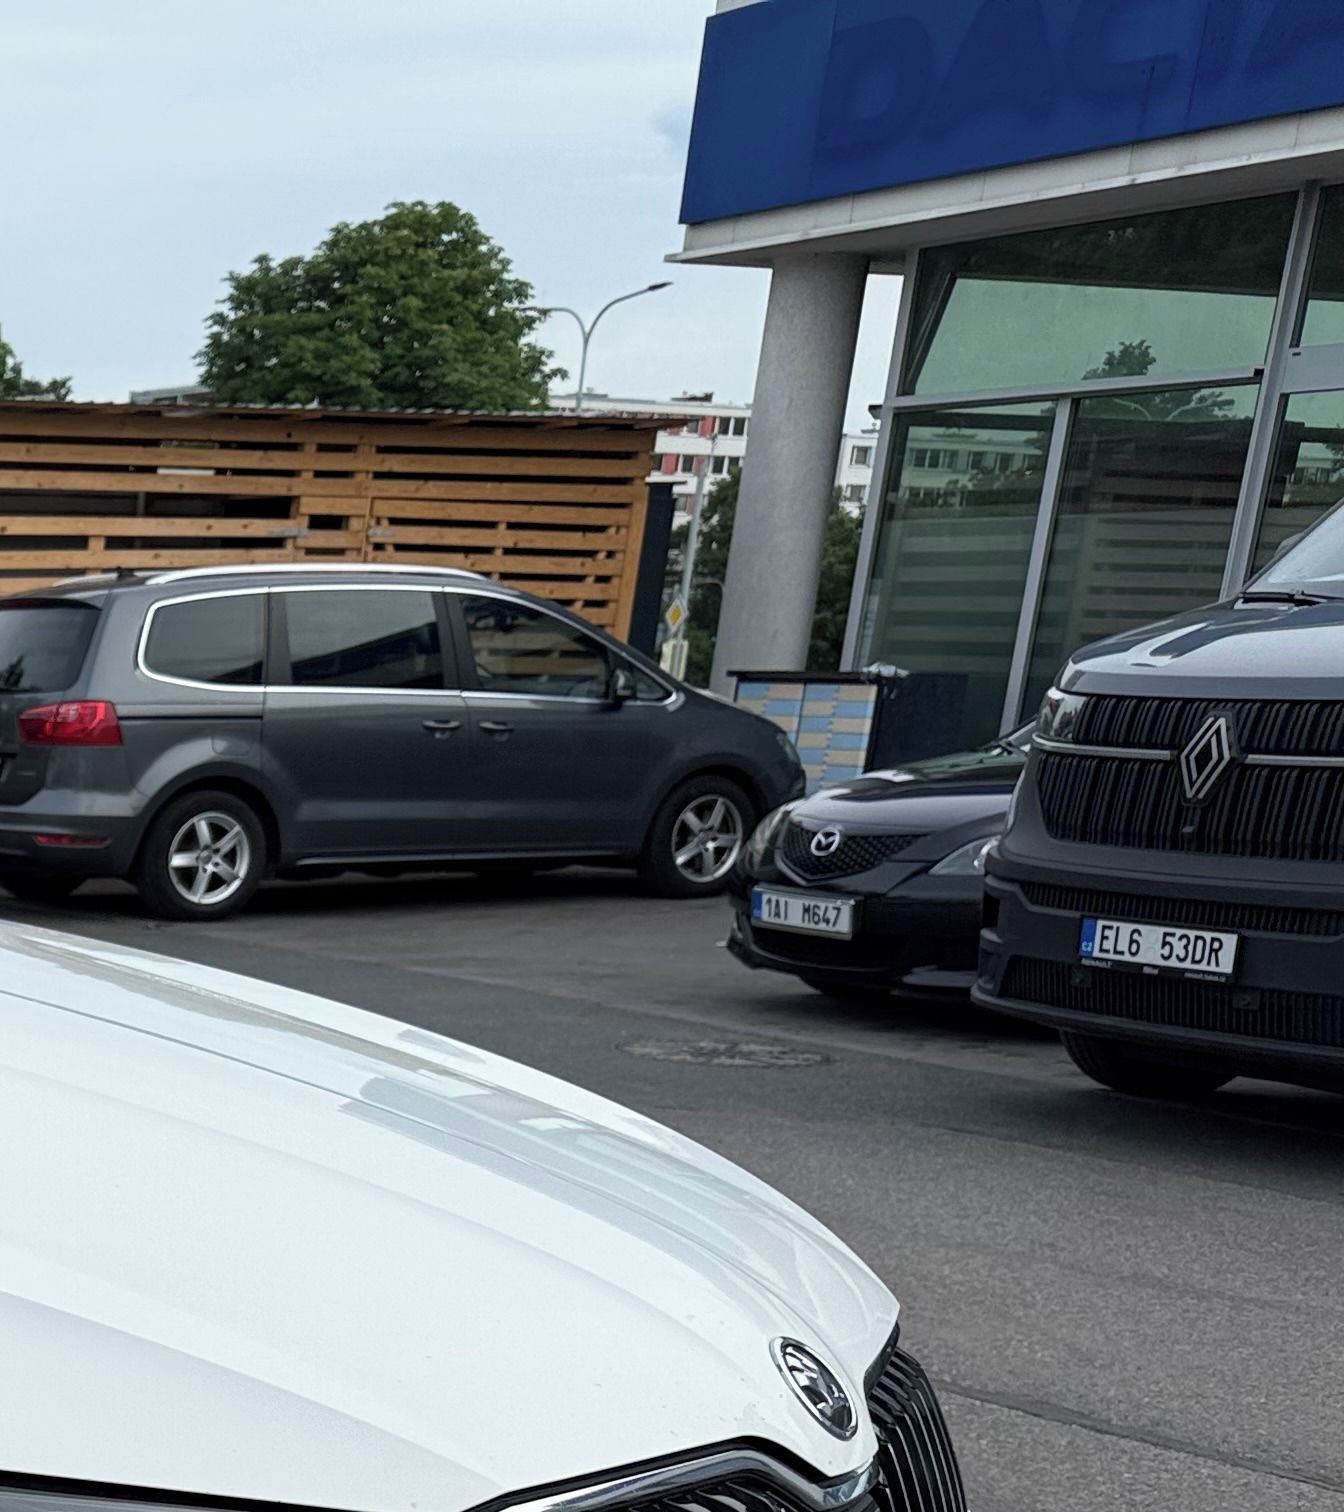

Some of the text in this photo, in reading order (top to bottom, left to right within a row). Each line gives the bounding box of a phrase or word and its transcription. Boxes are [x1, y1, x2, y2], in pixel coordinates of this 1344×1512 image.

[765, 897, 842, 928] 1AI M647
[1098, 924, 1224, 968] EL6 53DR
